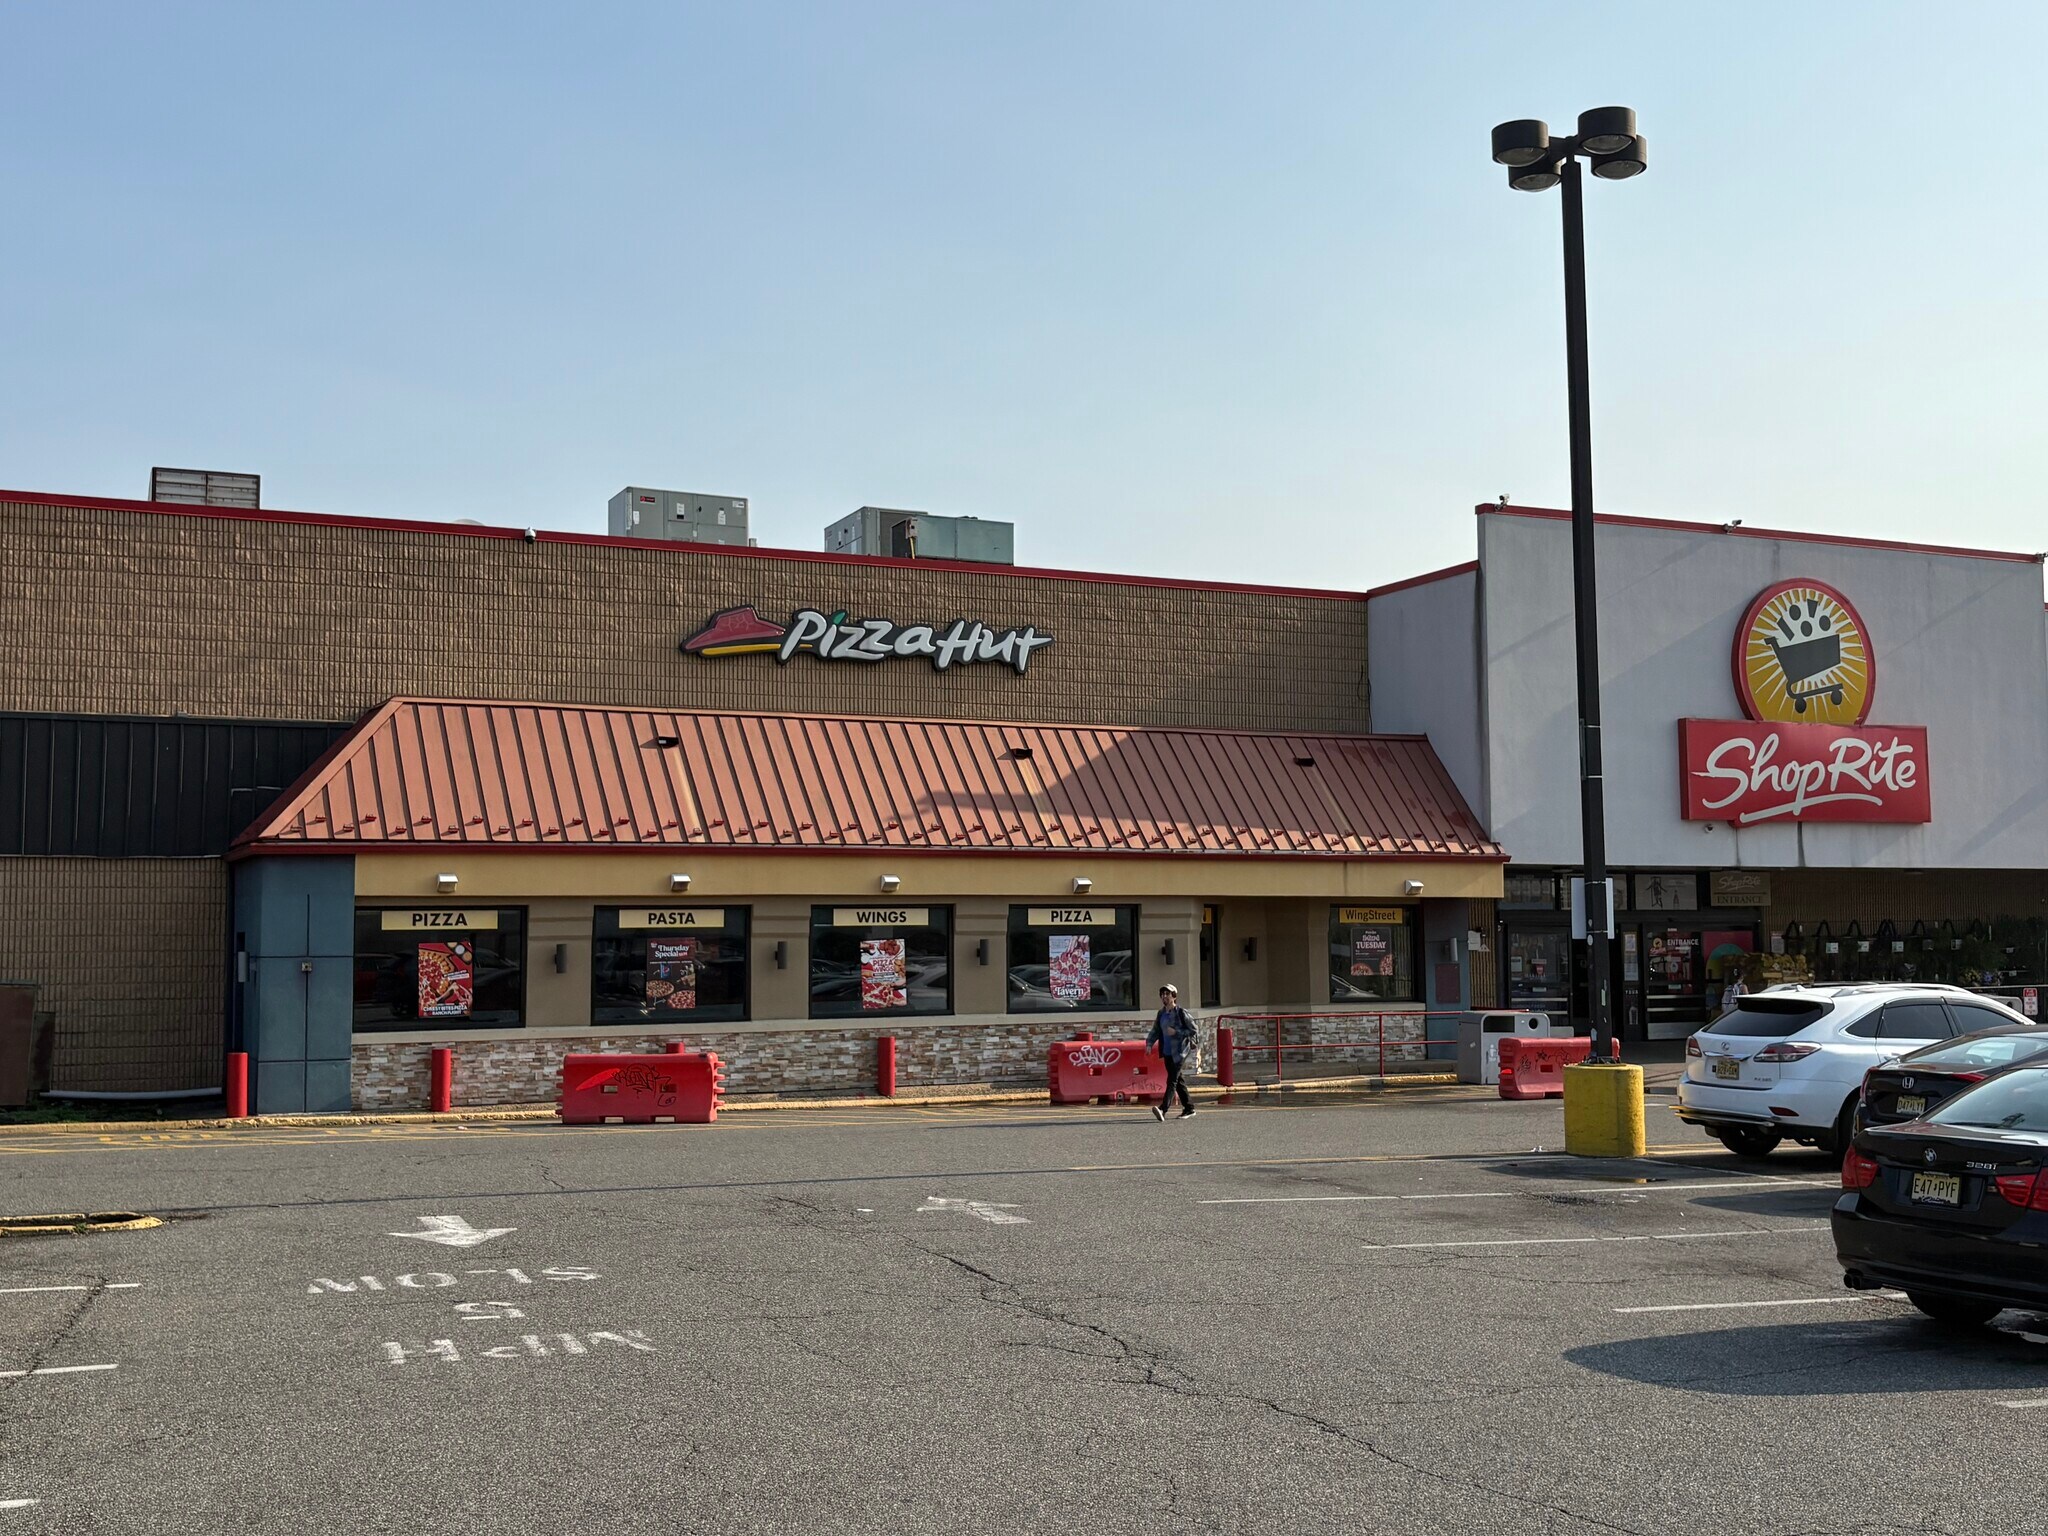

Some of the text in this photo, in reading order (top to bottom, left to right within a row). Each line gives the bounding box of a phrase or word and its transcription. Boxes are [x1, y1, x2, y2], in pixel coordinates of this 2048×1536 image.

[780, 610, 1053, 673] Pizza Hut
[1691, 733, 1917, 822] ShopRite
[412, 912, 467, 926] PIZZA
[648, 912, 696, 924] PASTA
[856, 911, 907, 923] WINGS
[1050, 910, 1093, 922] PIZZA
[1345, 909, 1396, 922] WingStreet
[657, 944, 689, 952] Thursday
[1356, 941, 1387, 949] TUESDAY
[1667, 938, 1699, 946] ENTRANCE
[1054, 986, 1084, 997] Tavern
[307, 1264, 601, 1294] SLOW
[453, 1301, 526, 1320] 5
